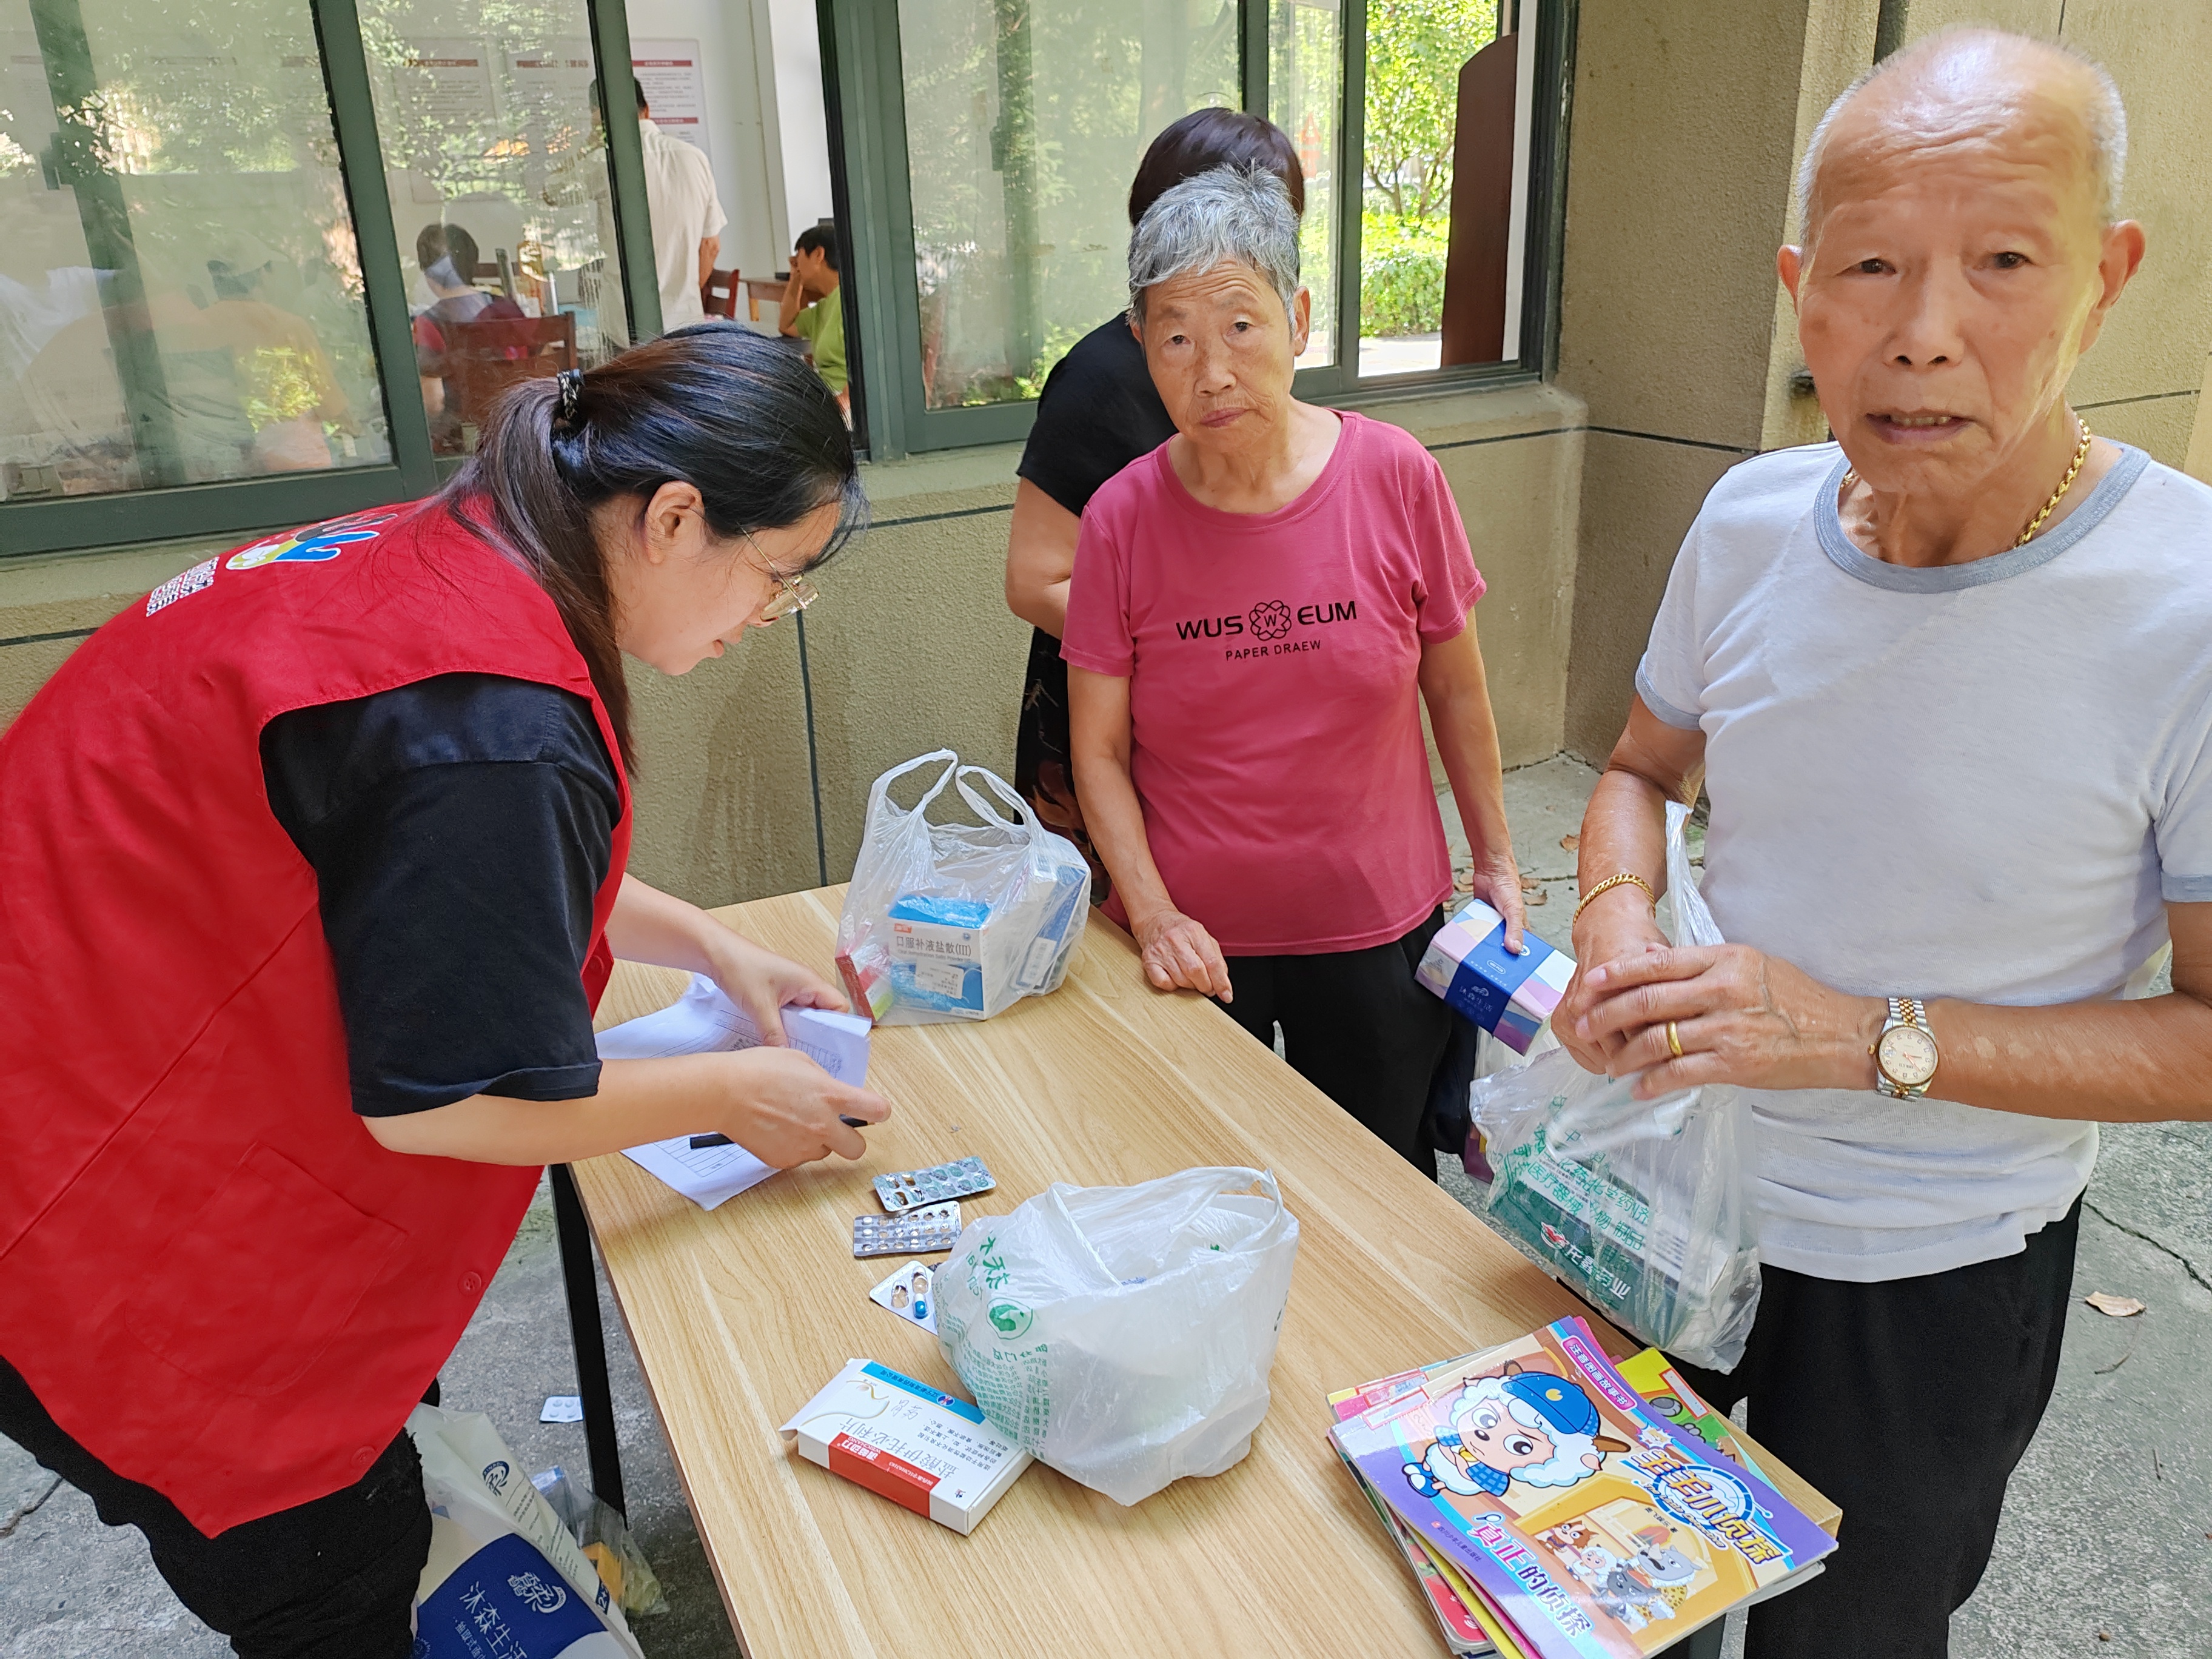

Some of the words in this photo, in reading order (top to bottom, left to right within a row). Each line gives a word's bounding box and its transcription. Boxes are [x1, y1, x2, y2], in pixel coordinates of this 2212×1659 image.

[1176, 615, 1243, 640] WUS
[1297, 600, 1357, 625] EUM
[1225, 646, 1269, 661] PAPER
[1274, 640, 1321, 655] DRAEW
[896, 936, 971, 957] 口服补液盐散(III)
[1569, 1344, 1629, 1406] 注音图画故事书
[839, 1417, 960, 1480] 盐酸伊托必利片
[1631, 1450, 1784, 1564] 羊羊小侦探
[1659, 1494, 1685, 1513] Little
[1436, 1524, 1482, 1563] 四川少年儿童出版社
[1467, 1522, 1591, 1637] 真正的侦探
